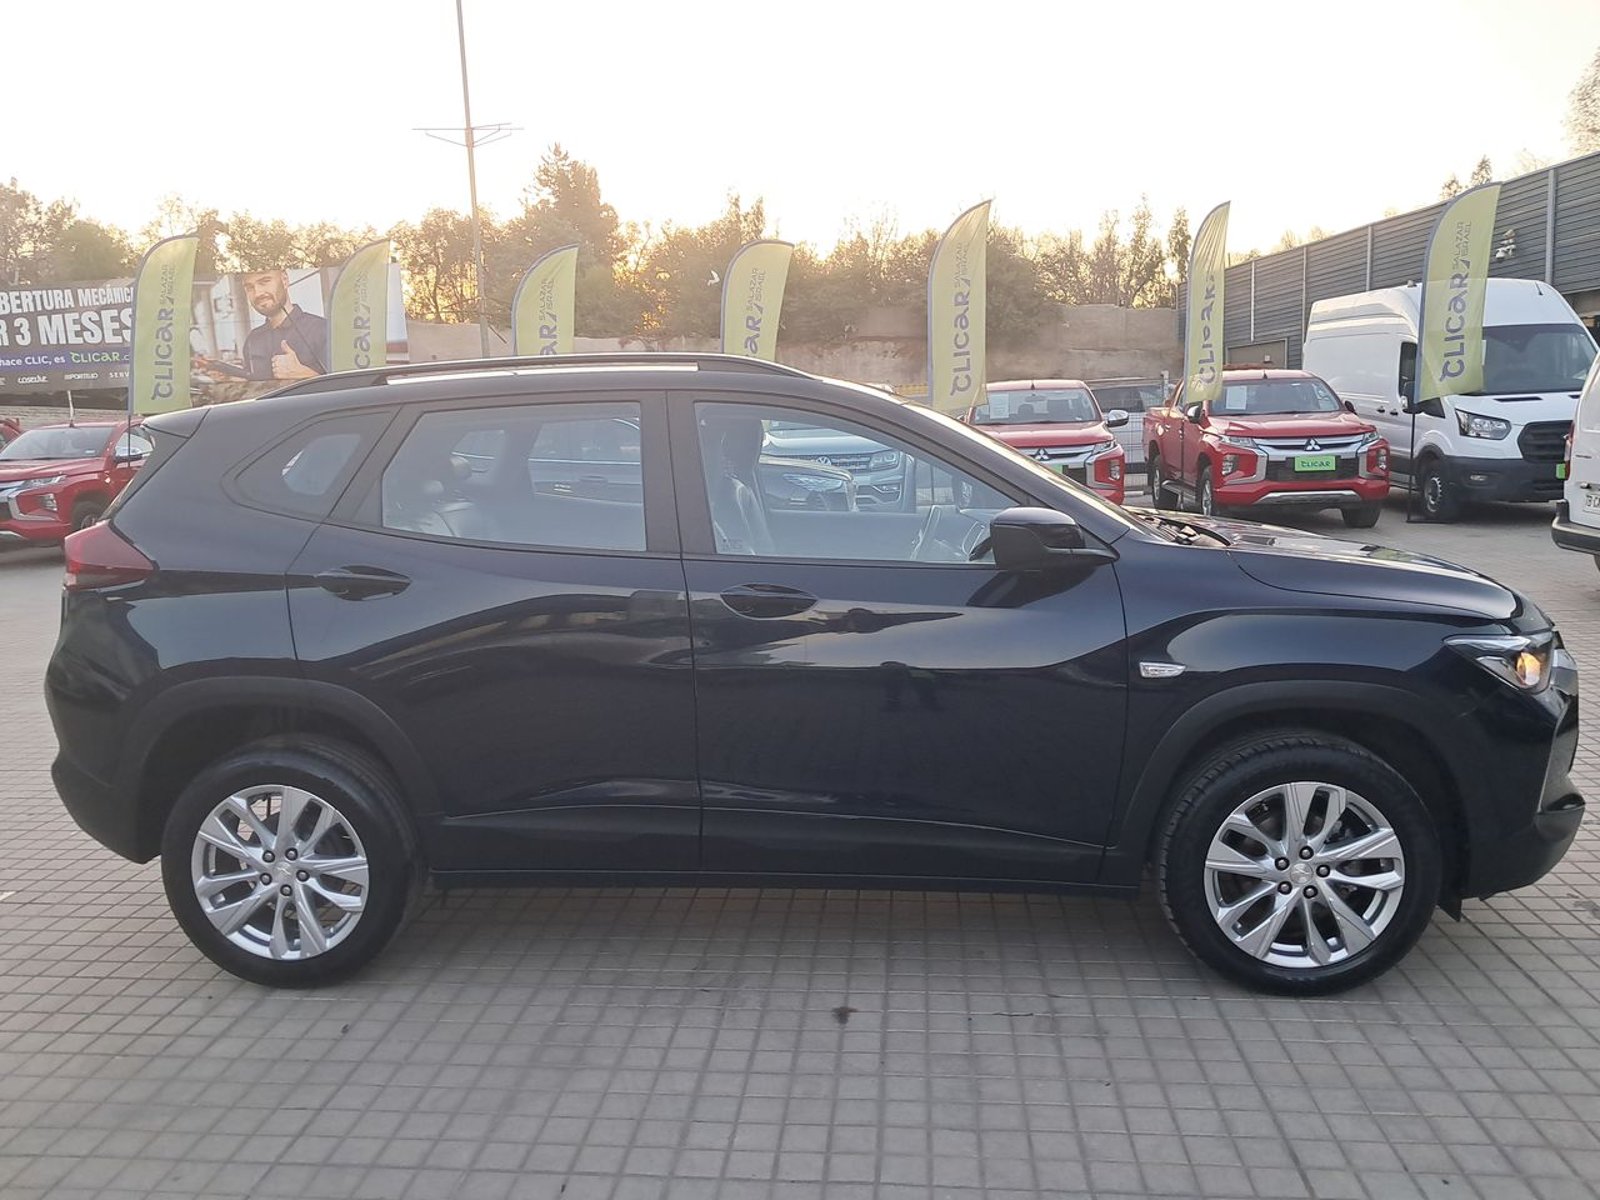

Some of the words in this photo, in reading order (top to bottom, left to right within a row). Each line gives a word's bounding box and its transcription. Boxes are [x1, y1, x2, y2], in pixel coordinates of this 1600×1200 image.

[77, 284, 134, 306] MECÁNIC
[14, 317, 31, 346] 3
[24, 355, 52, 365] CLIC,
